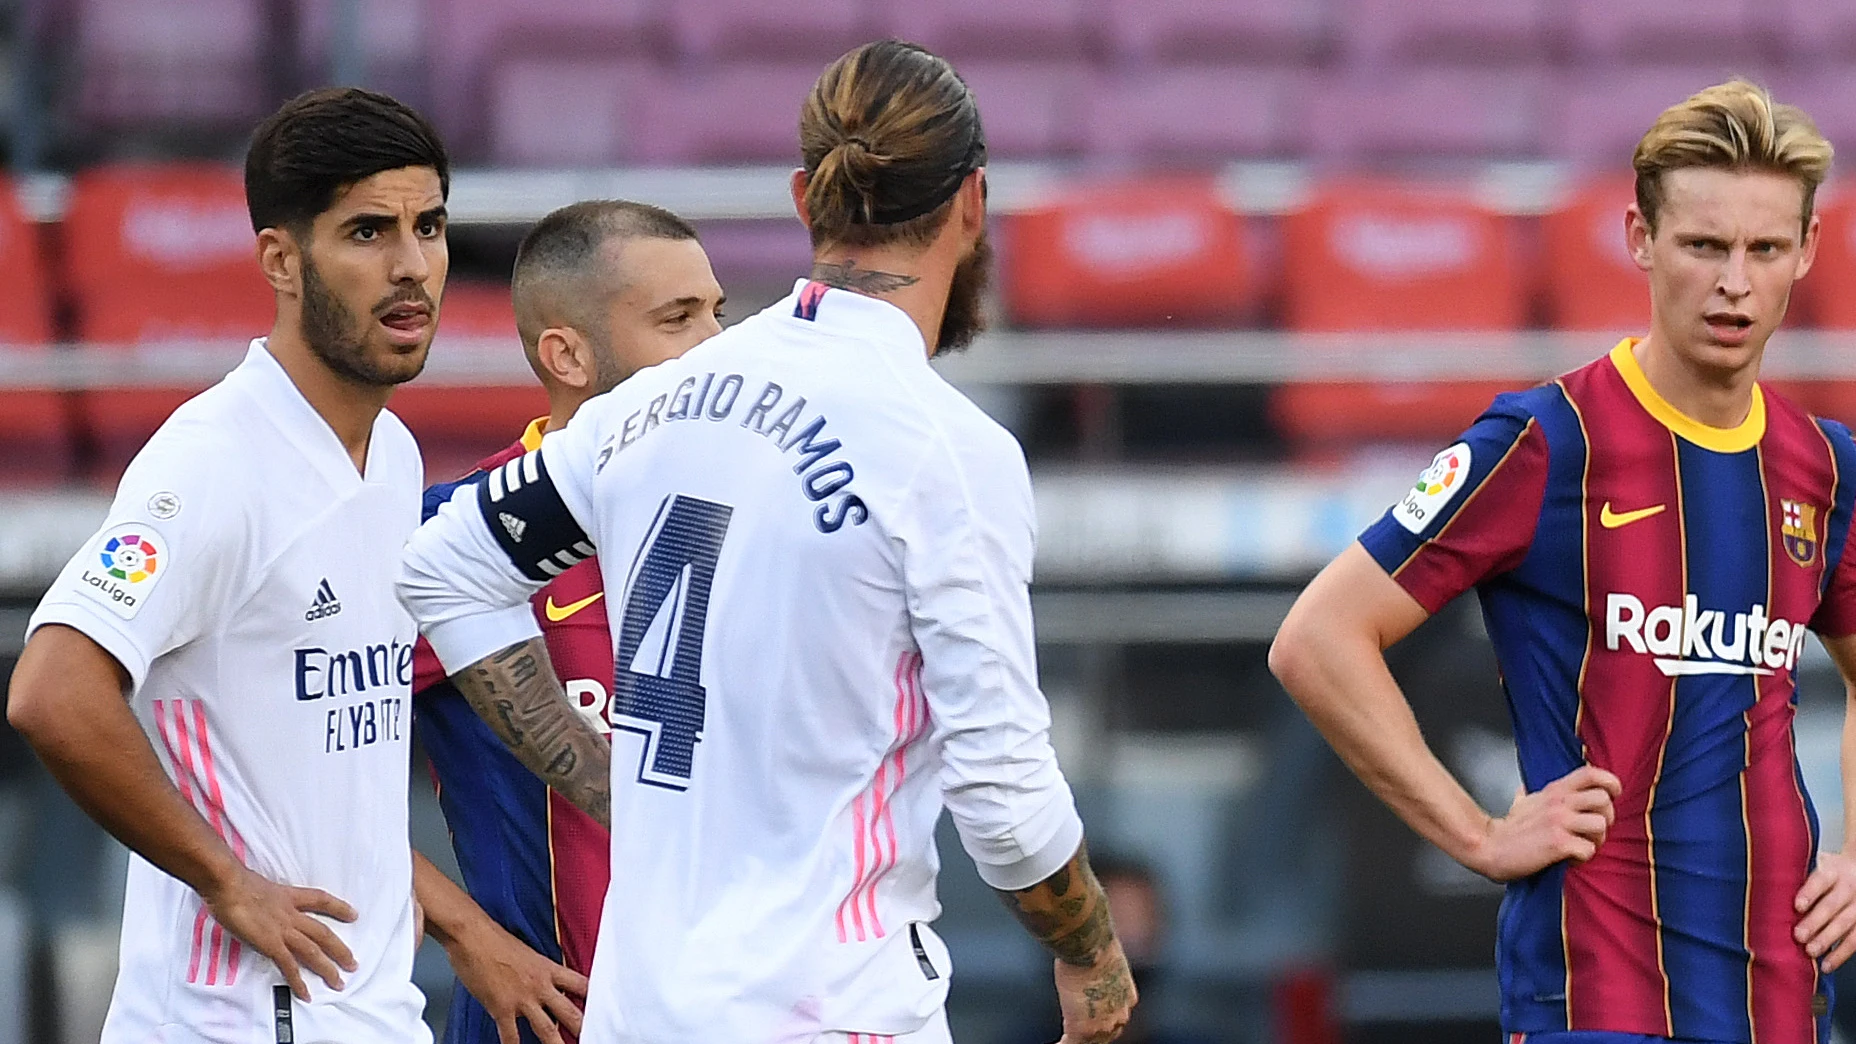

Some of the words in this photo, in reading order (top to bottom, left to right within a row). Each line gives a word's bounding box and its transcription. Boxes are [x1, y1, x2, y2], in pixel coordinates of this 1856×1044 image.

[596, 372, 744, 475] SERGIO
[740, 381, 869, 534] RAMOS
[81, 570, 137, 607] LaLiga
[612, 492, 736, 793] 4
[1606, 592, 1806, 671] Rakuten
